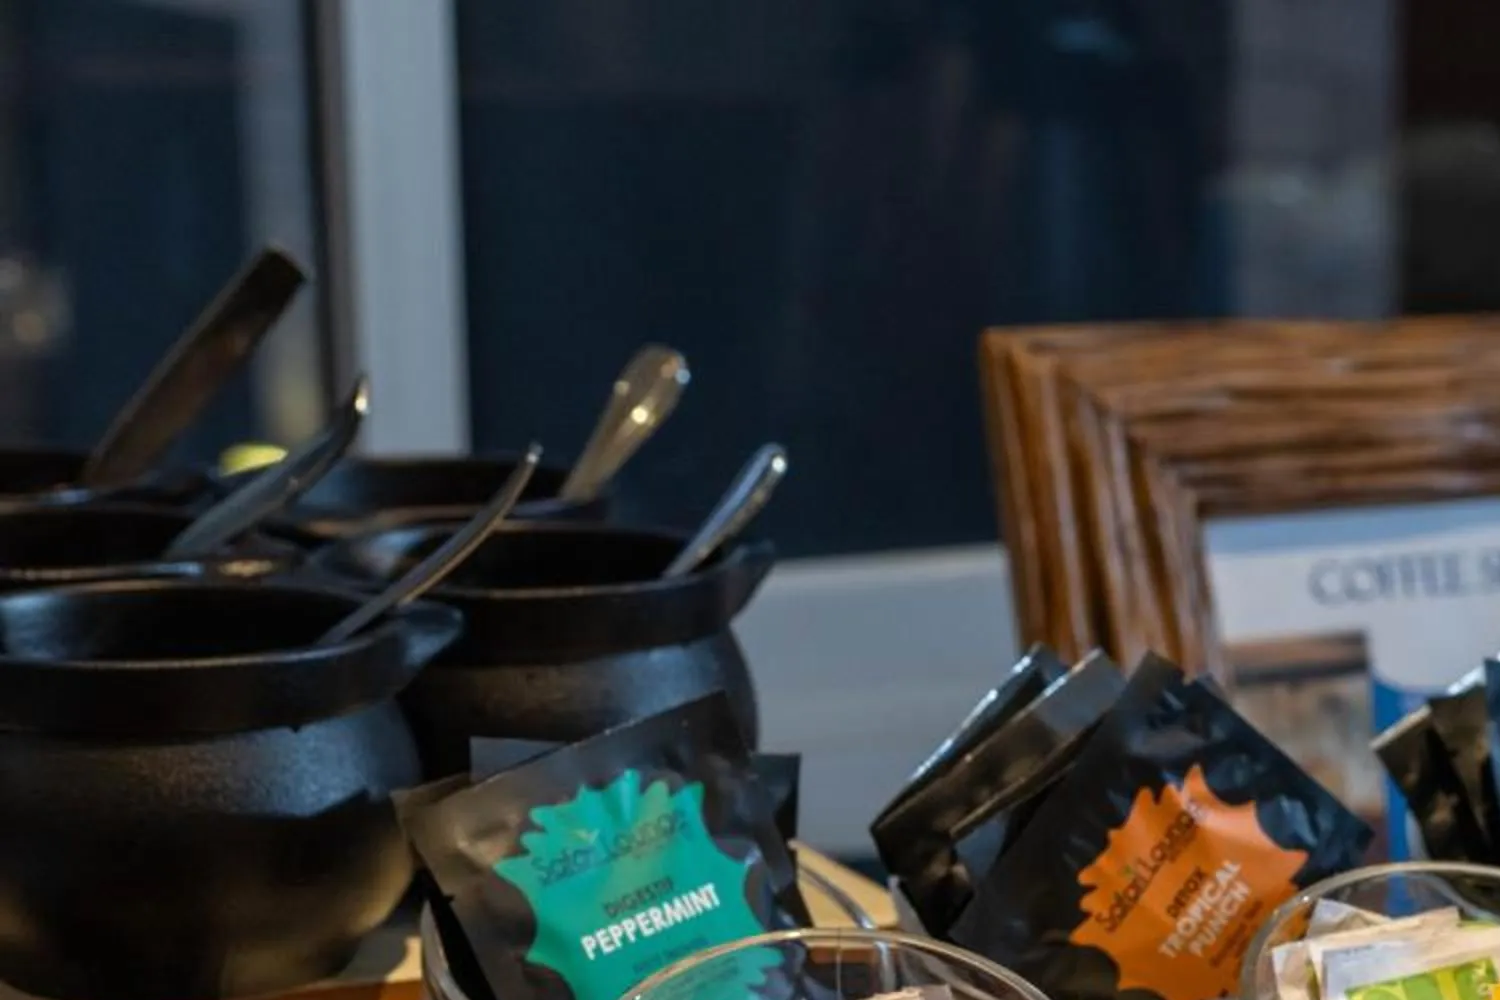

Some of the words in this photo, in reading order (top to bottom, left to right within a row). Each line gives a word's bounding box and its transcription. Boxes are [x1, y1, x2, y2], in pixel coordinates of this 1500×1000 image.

[1309, 551, 1464, 604] COFFEE
[580, 882, 721, 961] PEPPERMINT
[1158, 859, 1241, 957] TROPICAL
[1188, 879, 1251, 958] PUNCH
